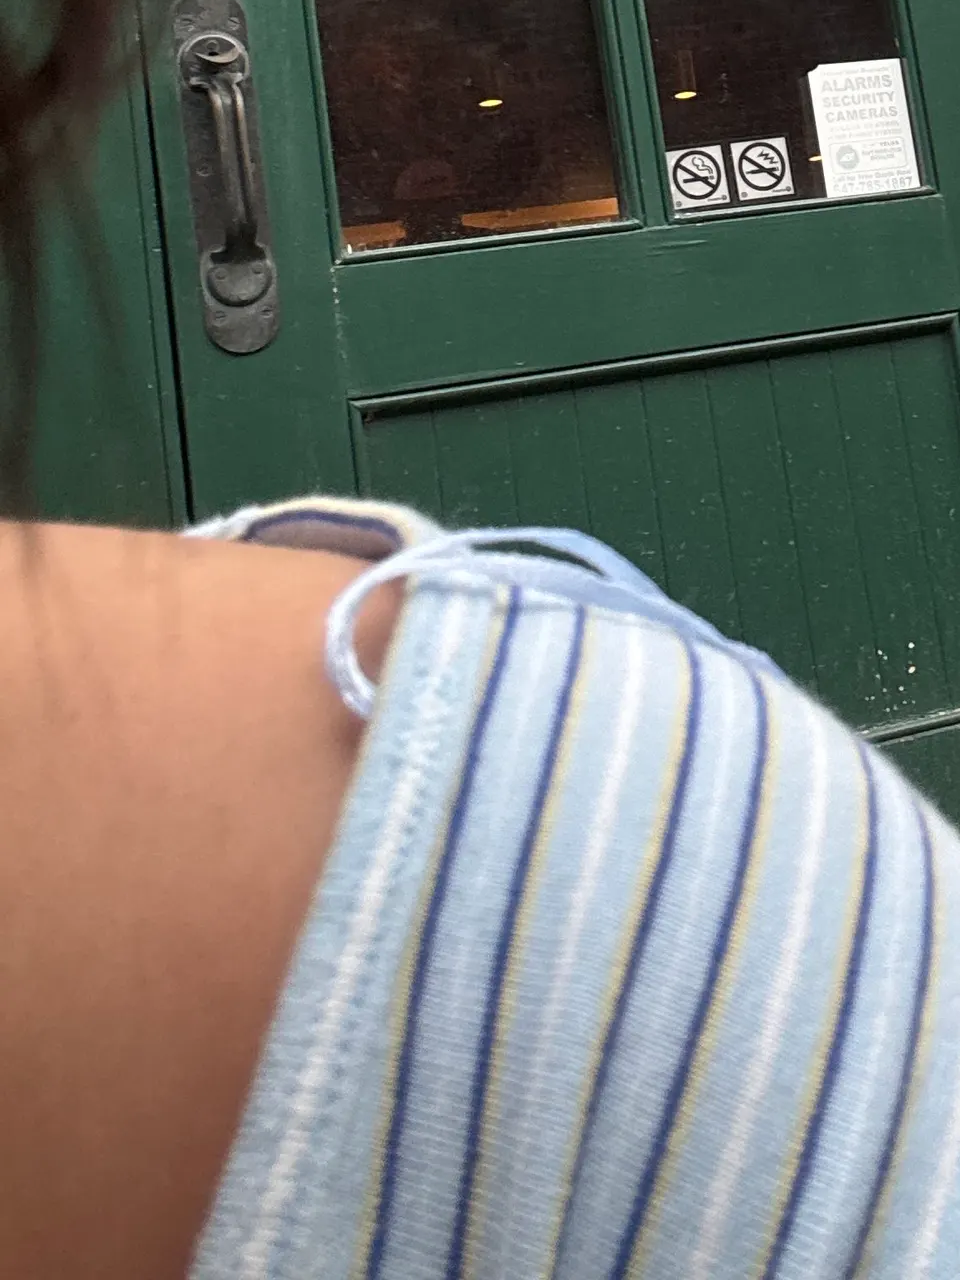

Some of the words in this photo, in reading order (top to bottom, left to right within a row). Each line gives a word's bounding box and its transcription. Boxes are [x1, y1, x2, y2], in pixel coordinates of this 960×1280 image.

[821, 74, 893, 92] ALARMS
[822, 91, 895, 108] SECURITY
[825, 106, 898, 123] CAMERAS
